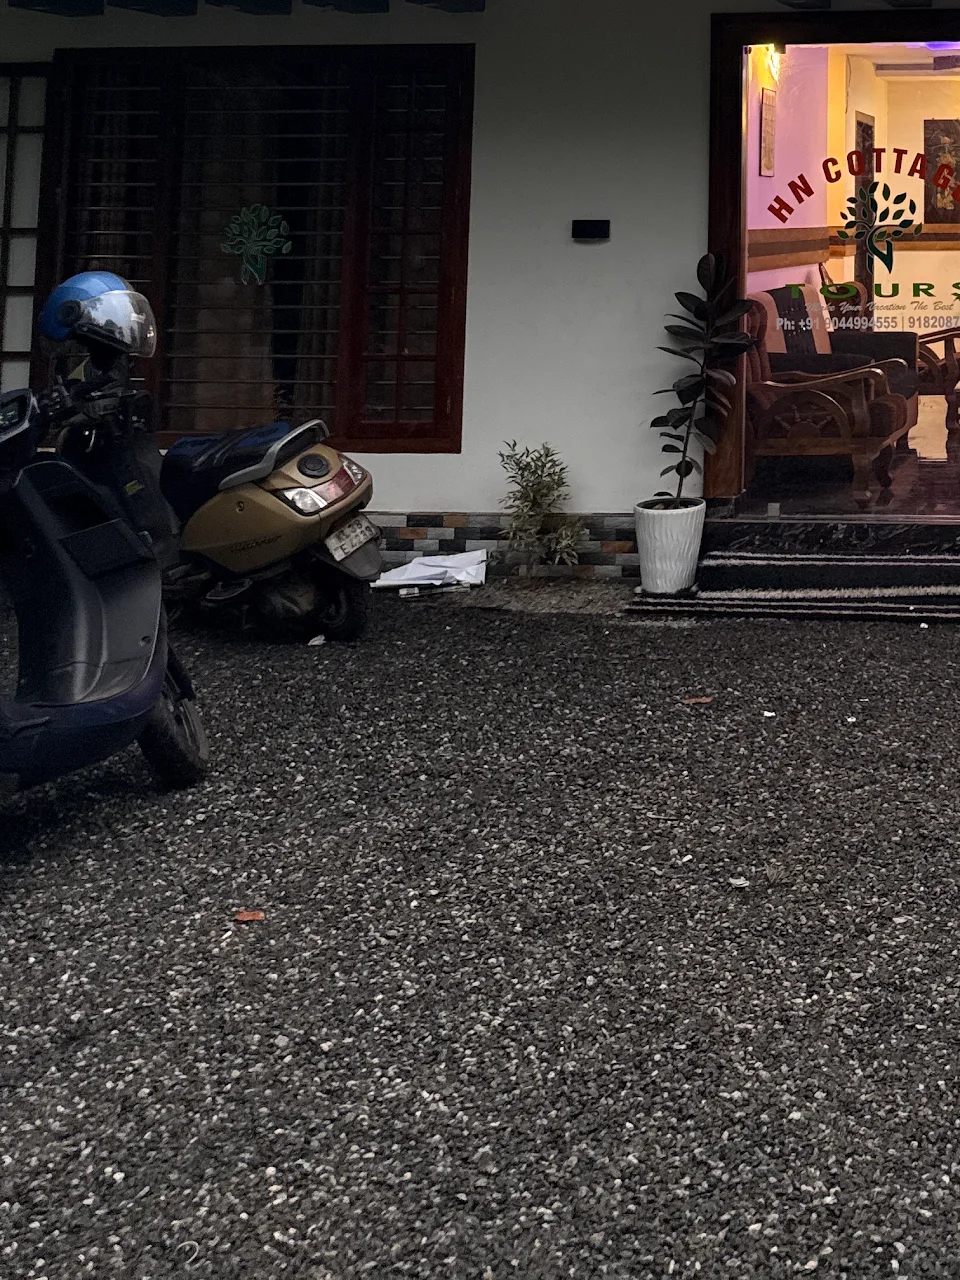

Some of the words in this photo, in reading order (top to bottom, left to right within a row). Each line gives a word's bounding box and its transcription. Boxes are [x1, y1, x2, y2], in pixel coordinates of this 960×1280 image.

[766, 173, 815, 224] HN
[839, 301, 862, 314] Your
[867, 301, 906, 312] Vacation
[910, 300, 929, 311] The
[933, 300, 955, 311] Best
[776, 317, 796, 331] Ph:
[799, 317, 820, 330] +91
[824, 315, 898, 330] 9044994555
